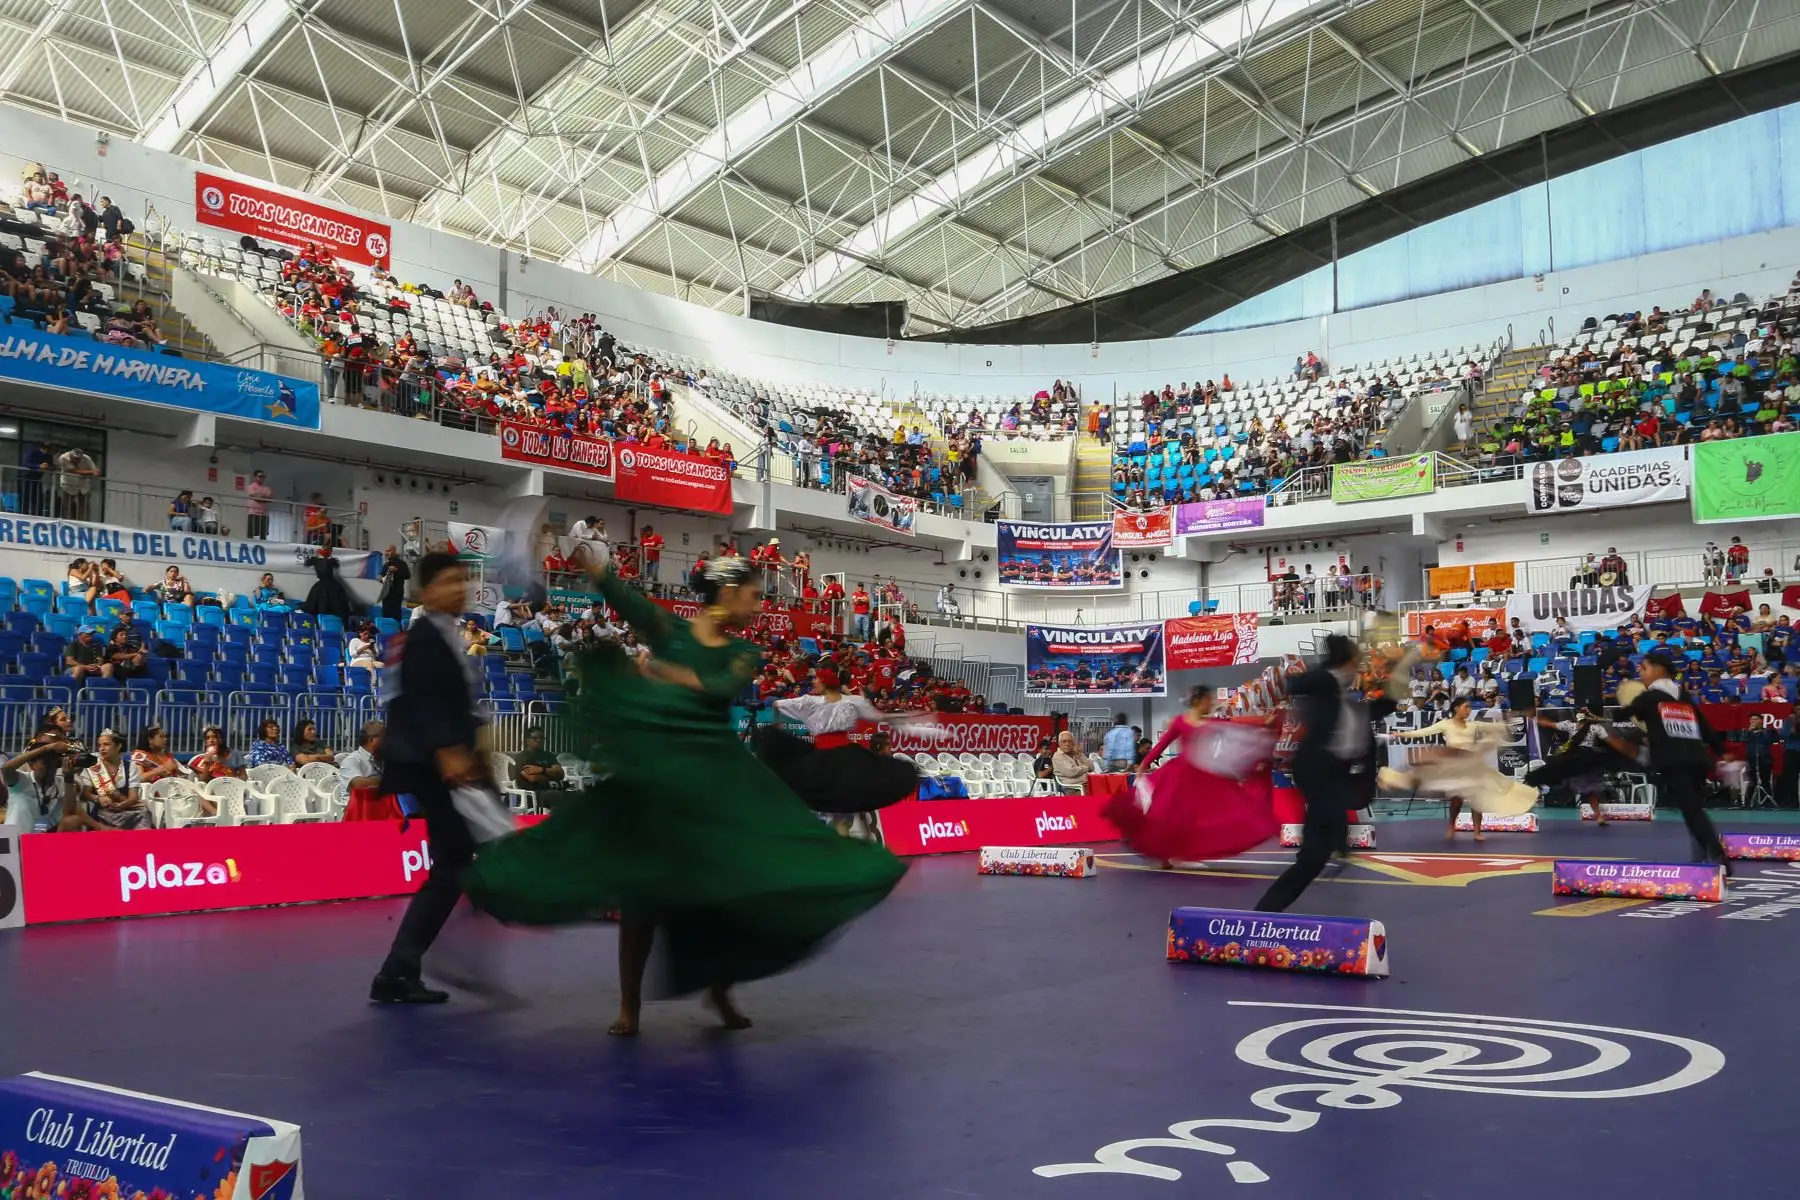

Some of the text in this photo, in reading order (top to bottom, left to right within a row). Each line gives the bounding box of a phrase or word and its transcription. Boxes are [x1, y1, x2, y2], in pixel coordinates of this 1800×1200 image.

[230, 193, 361, 246] TODAS LAS SANGRES
[1562, 287, 1570, 295] D
[56, 347, 89, 370] DE
[95, 354, 207, 392] MARINERA
[521, 430, 608, 468] TODAS LAS SANGRES
[636, 452, 727, 481] TODAS LAS SANGRES
[1589, 461, 1671, 479] ACADEMIAS
[1589, 471, 1671, 494] UNIDAS
[0, 518, 126, 553] REGIONAL
[132, 532, 177, 558] DEL
[182, 537, 266, 566] CALLAO
[1010, 525, 1106, 540] VINCULATV
[1532, 585, 1635, 620] UNIDAS
[1042, 629, 1149, 643] VINCULATV
[1170, 632, 1212, 648] Madeleine
[934, 723, 966, 751] LAS
[968, 723, 1040, 753] SANGRES
[1748, 835, 1773, 846] Club
[1000, 849, 1059, 860] Club Libertad
[1586, 864, 1681, 879] Club Libertad
[1208, 918, 1322, 942] Club Libertad
[1245, 940, 1280, 949] TRUJILLO
[26, 1107, 177, 1172] Club Libertad
[66, 1158, 110, 1182] TRUJILLO
